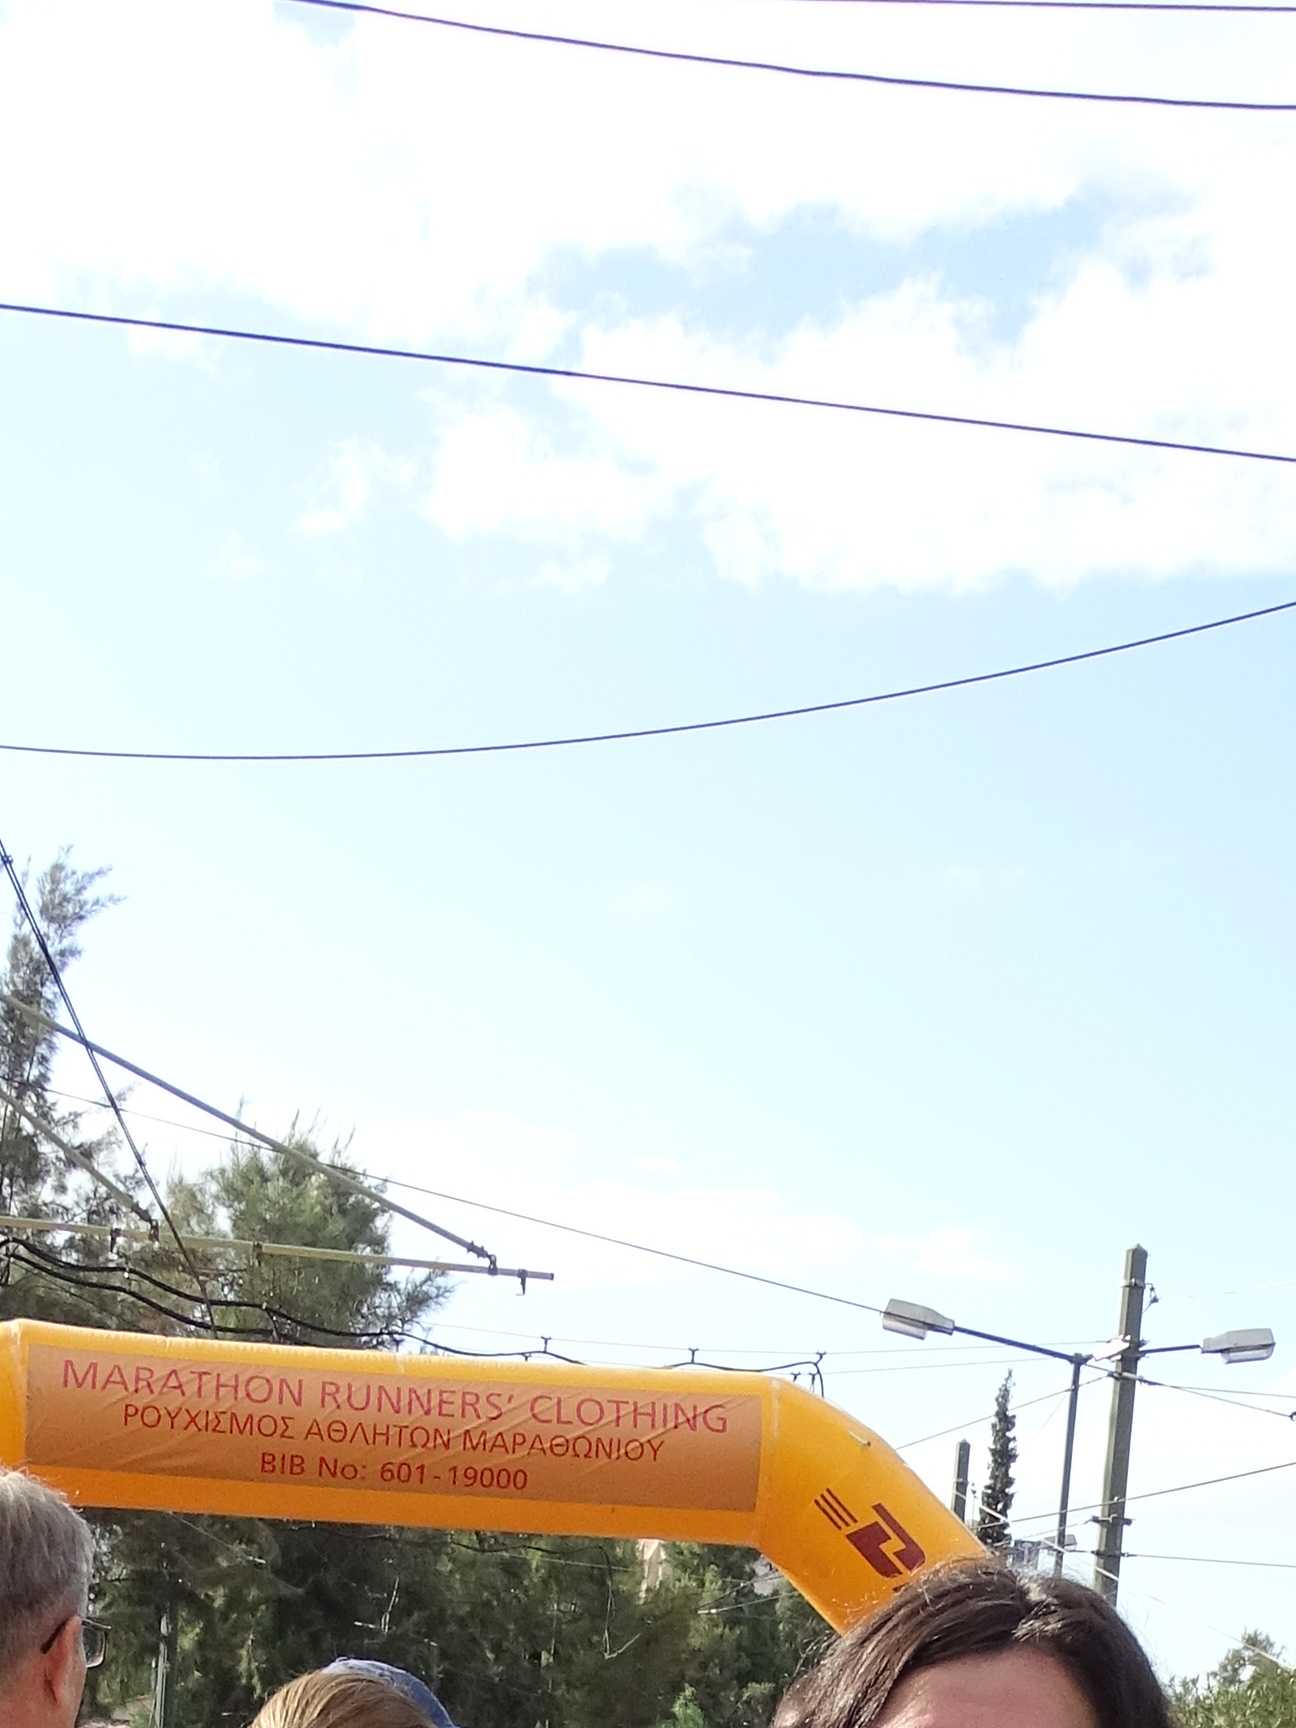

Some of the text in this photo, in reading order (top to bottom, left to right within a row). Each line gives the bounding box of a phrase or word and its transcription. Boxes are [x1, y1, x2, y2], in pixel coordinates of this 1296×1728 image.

[61, 1358, 304, 1408] MARATHON
[529, 1395, 728, 1434] CLOTHING
[123, 1403, 665, 1462] ΡΟΥΧΙΣΜΟΣ ΑΘΛΗΤΩΝ ΜΑΡΑΘΩΝΙΟΥ
[260, 1452, 305, 1476] BIB
[317, 1455, 367, 1481] No:
